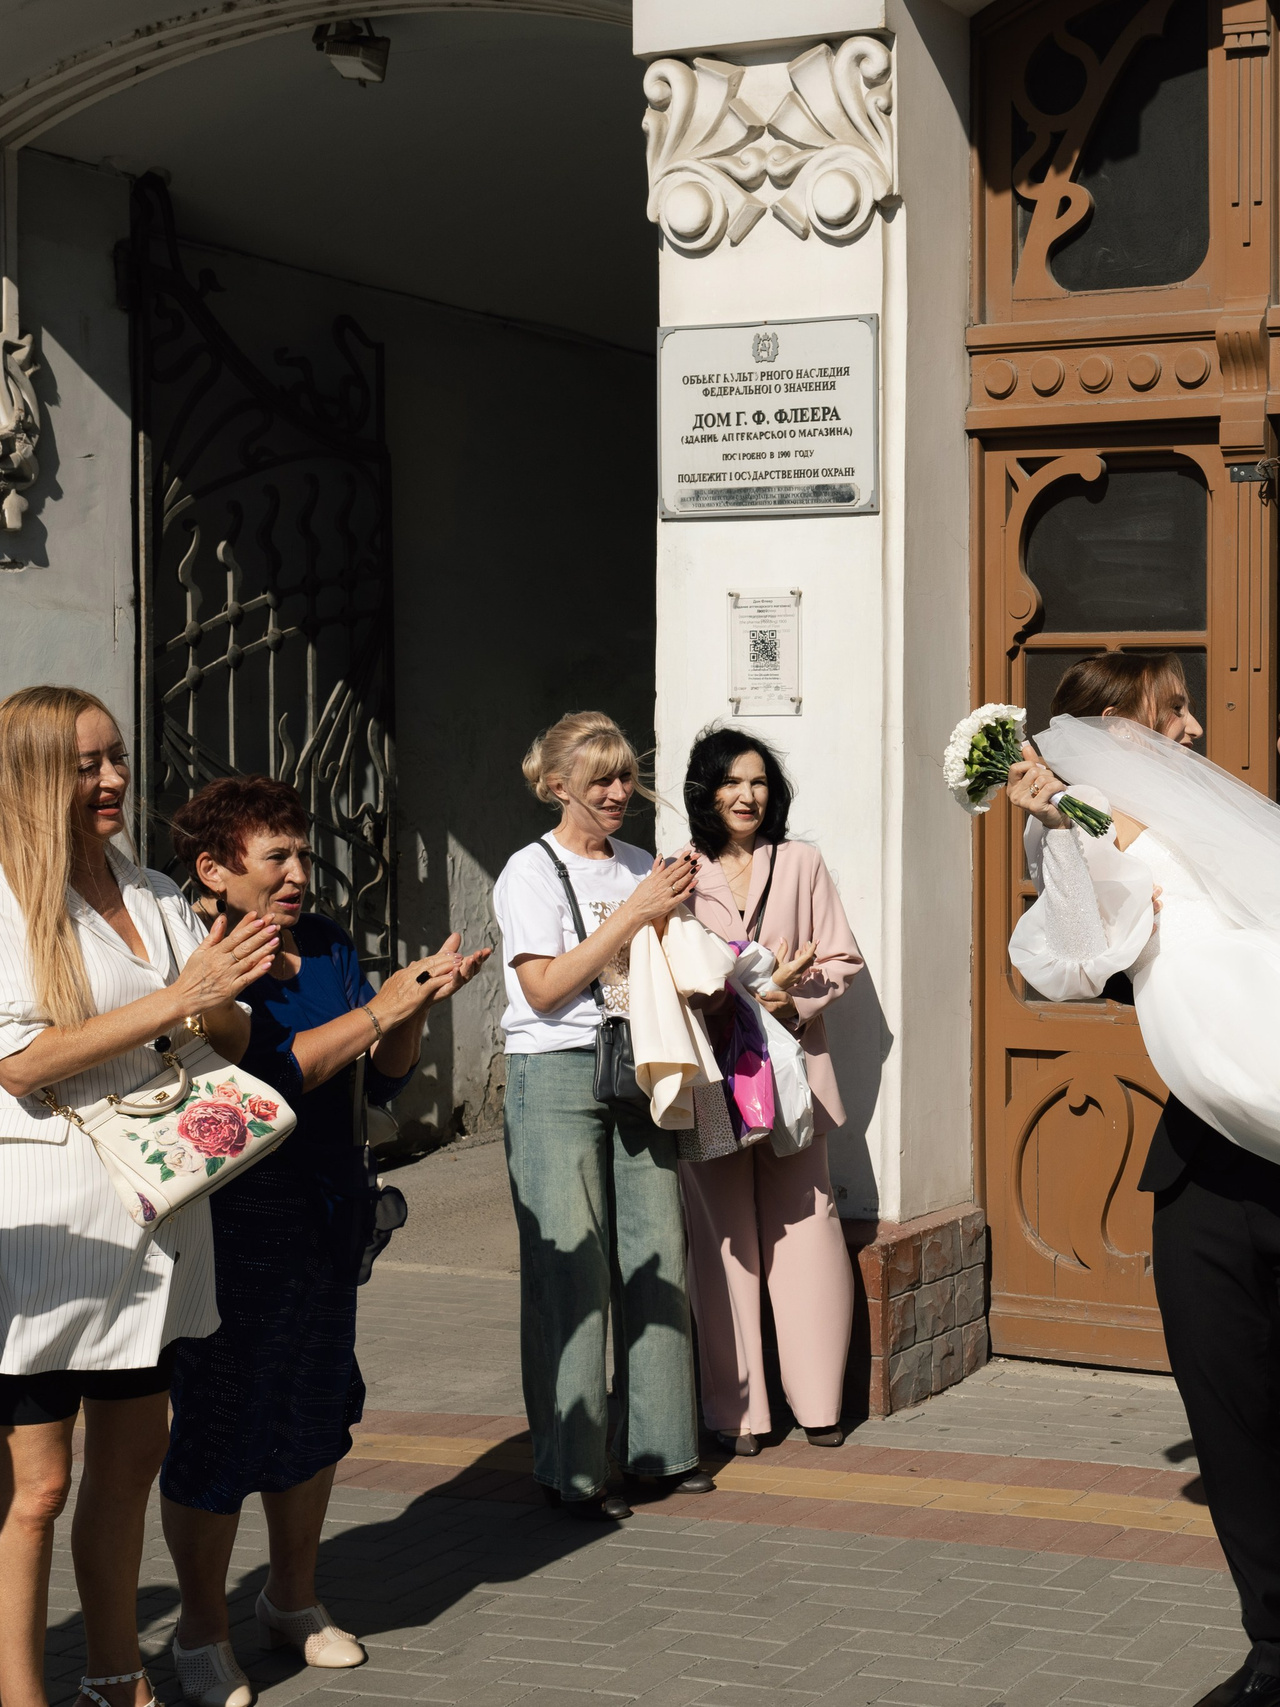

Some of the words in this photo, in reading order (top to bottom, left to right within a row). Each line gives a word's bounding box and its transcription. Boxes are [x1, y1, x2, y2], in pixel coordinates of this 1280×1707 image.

[796, 367, 850, 379] НАСЛЕДИЯ
[784, 381, 836, 393] ЗНАЧЕНИЯ
[692, 412, 731, 431] ДОМ
[736, 411, 747, 426] Г.
[752, 410, 769, 425] Ф.
[774, 406, 841, 423] ФЛЕЕРА
[799, 427, 852, 437] МАГАЗИНА)
[769, 451, 775, 460] В
[795, 450, 814, 458] ГОДУ
[678, 472, 727, 483] ПОДЛЕЖИТ
